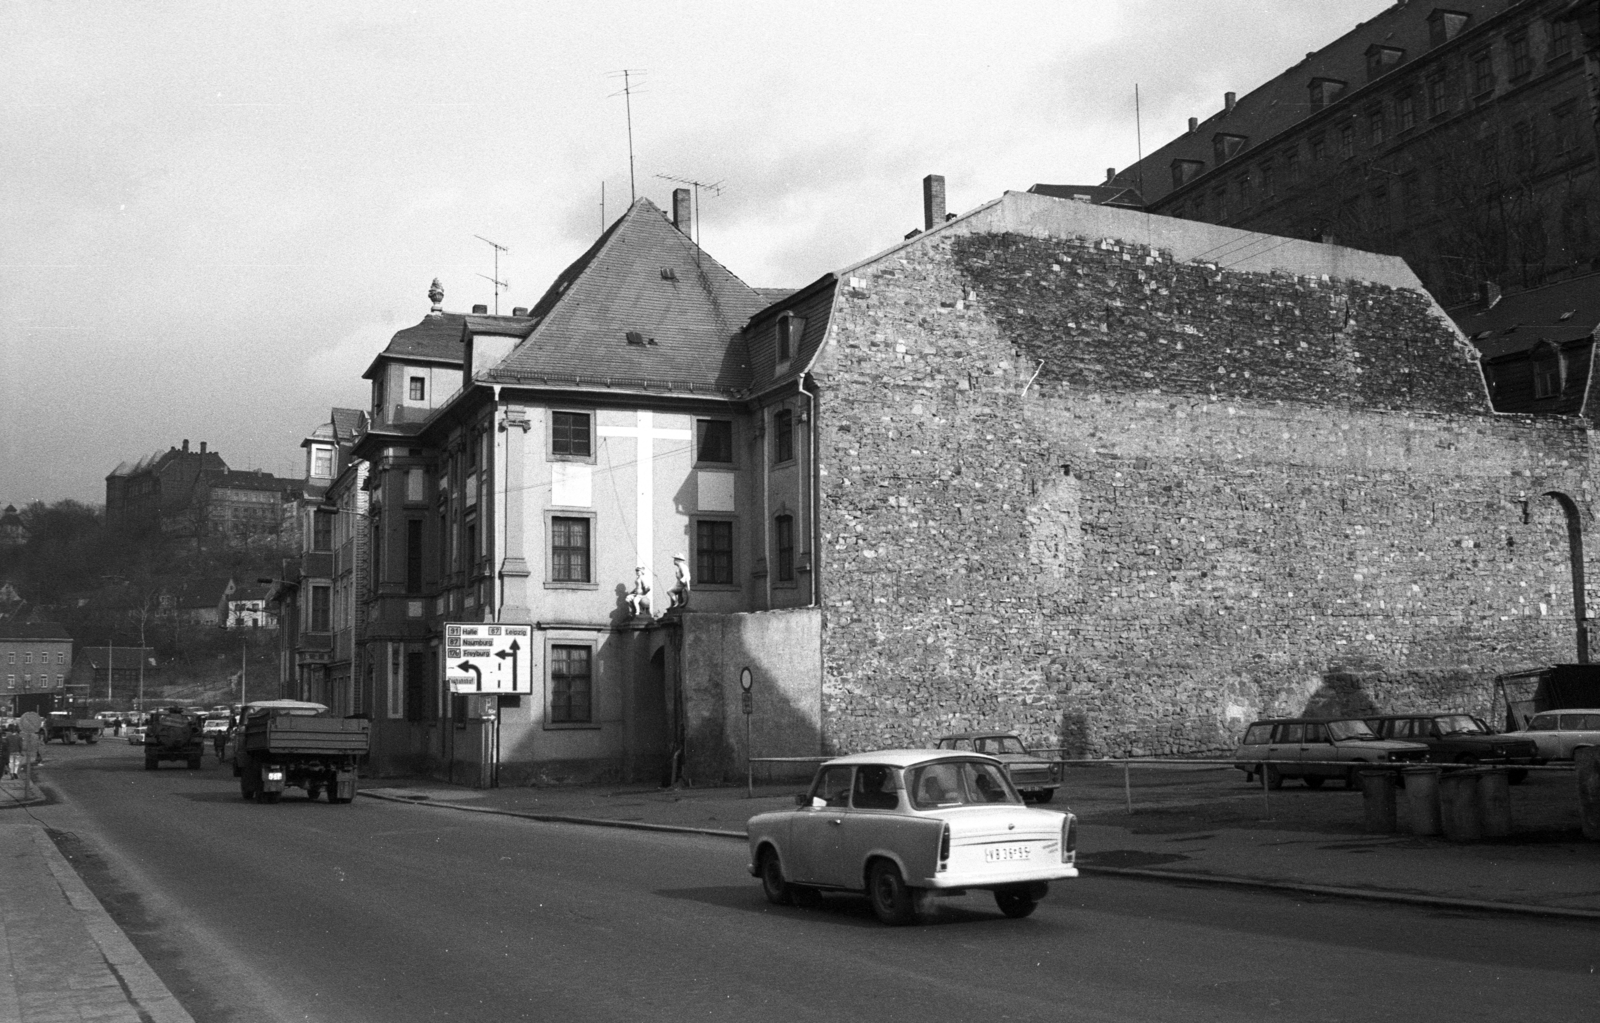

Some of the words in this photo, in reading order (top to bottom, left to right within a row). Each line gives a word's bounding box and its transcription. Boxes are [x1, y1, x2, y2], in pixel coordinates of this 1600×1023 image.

[450, 627, 459, 635] 91
[505, 628, 527, 636] Leipzig
[462, 639, 493, 647] Naumburg
[463, 649, 490, 658] Freyburg
